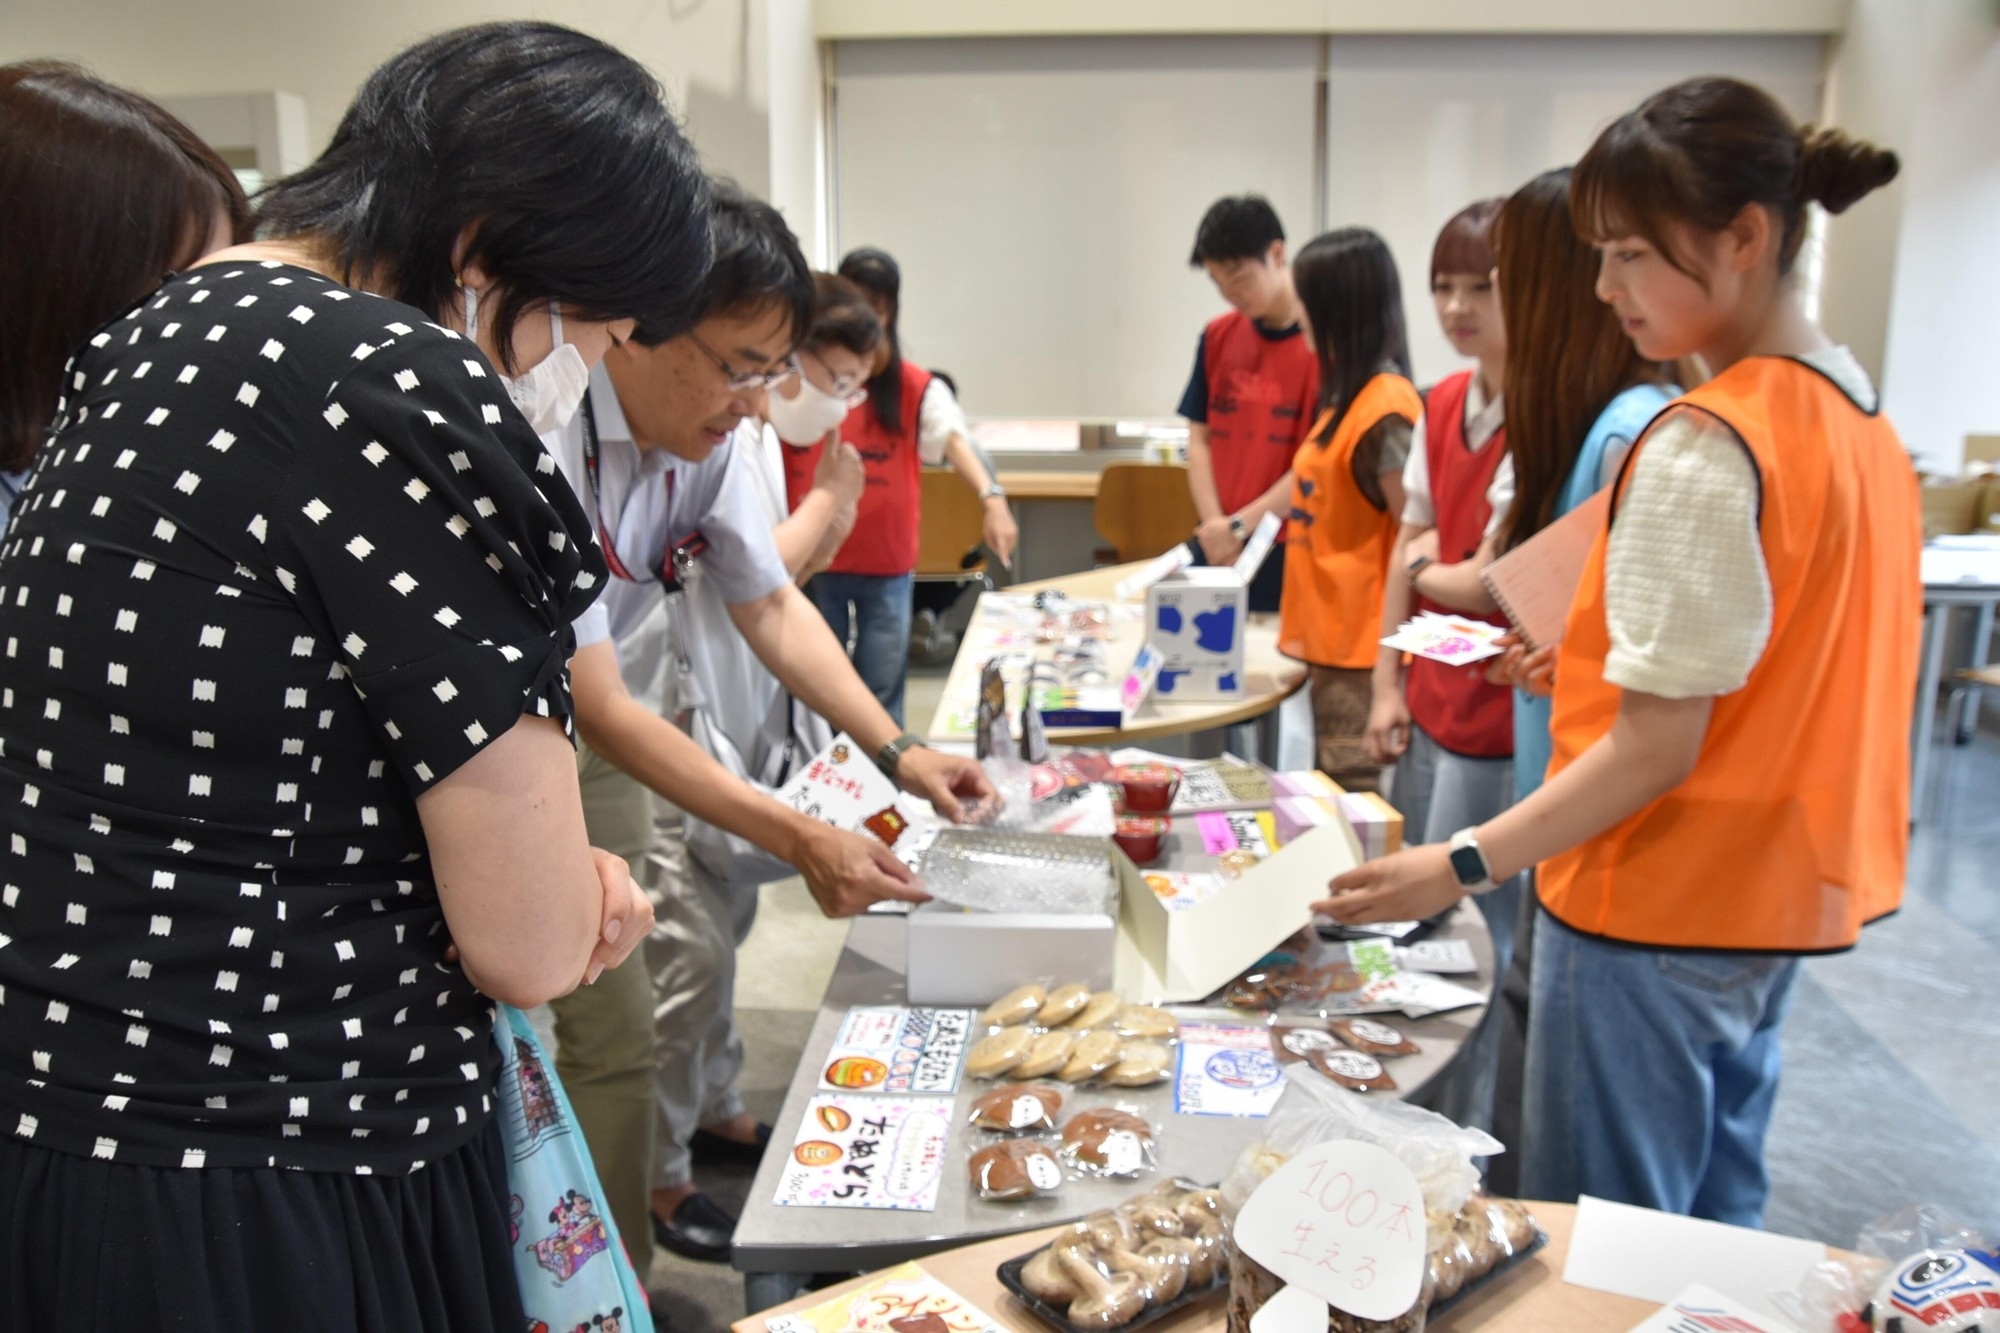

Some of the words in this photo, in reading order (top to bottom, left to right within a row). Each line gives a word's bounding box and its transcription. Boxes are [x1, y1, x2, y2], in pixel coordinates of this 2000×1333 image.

[1299, 1159, 1414, 1242] 100本
[1280, 1222, 1377, 1290] 生える
